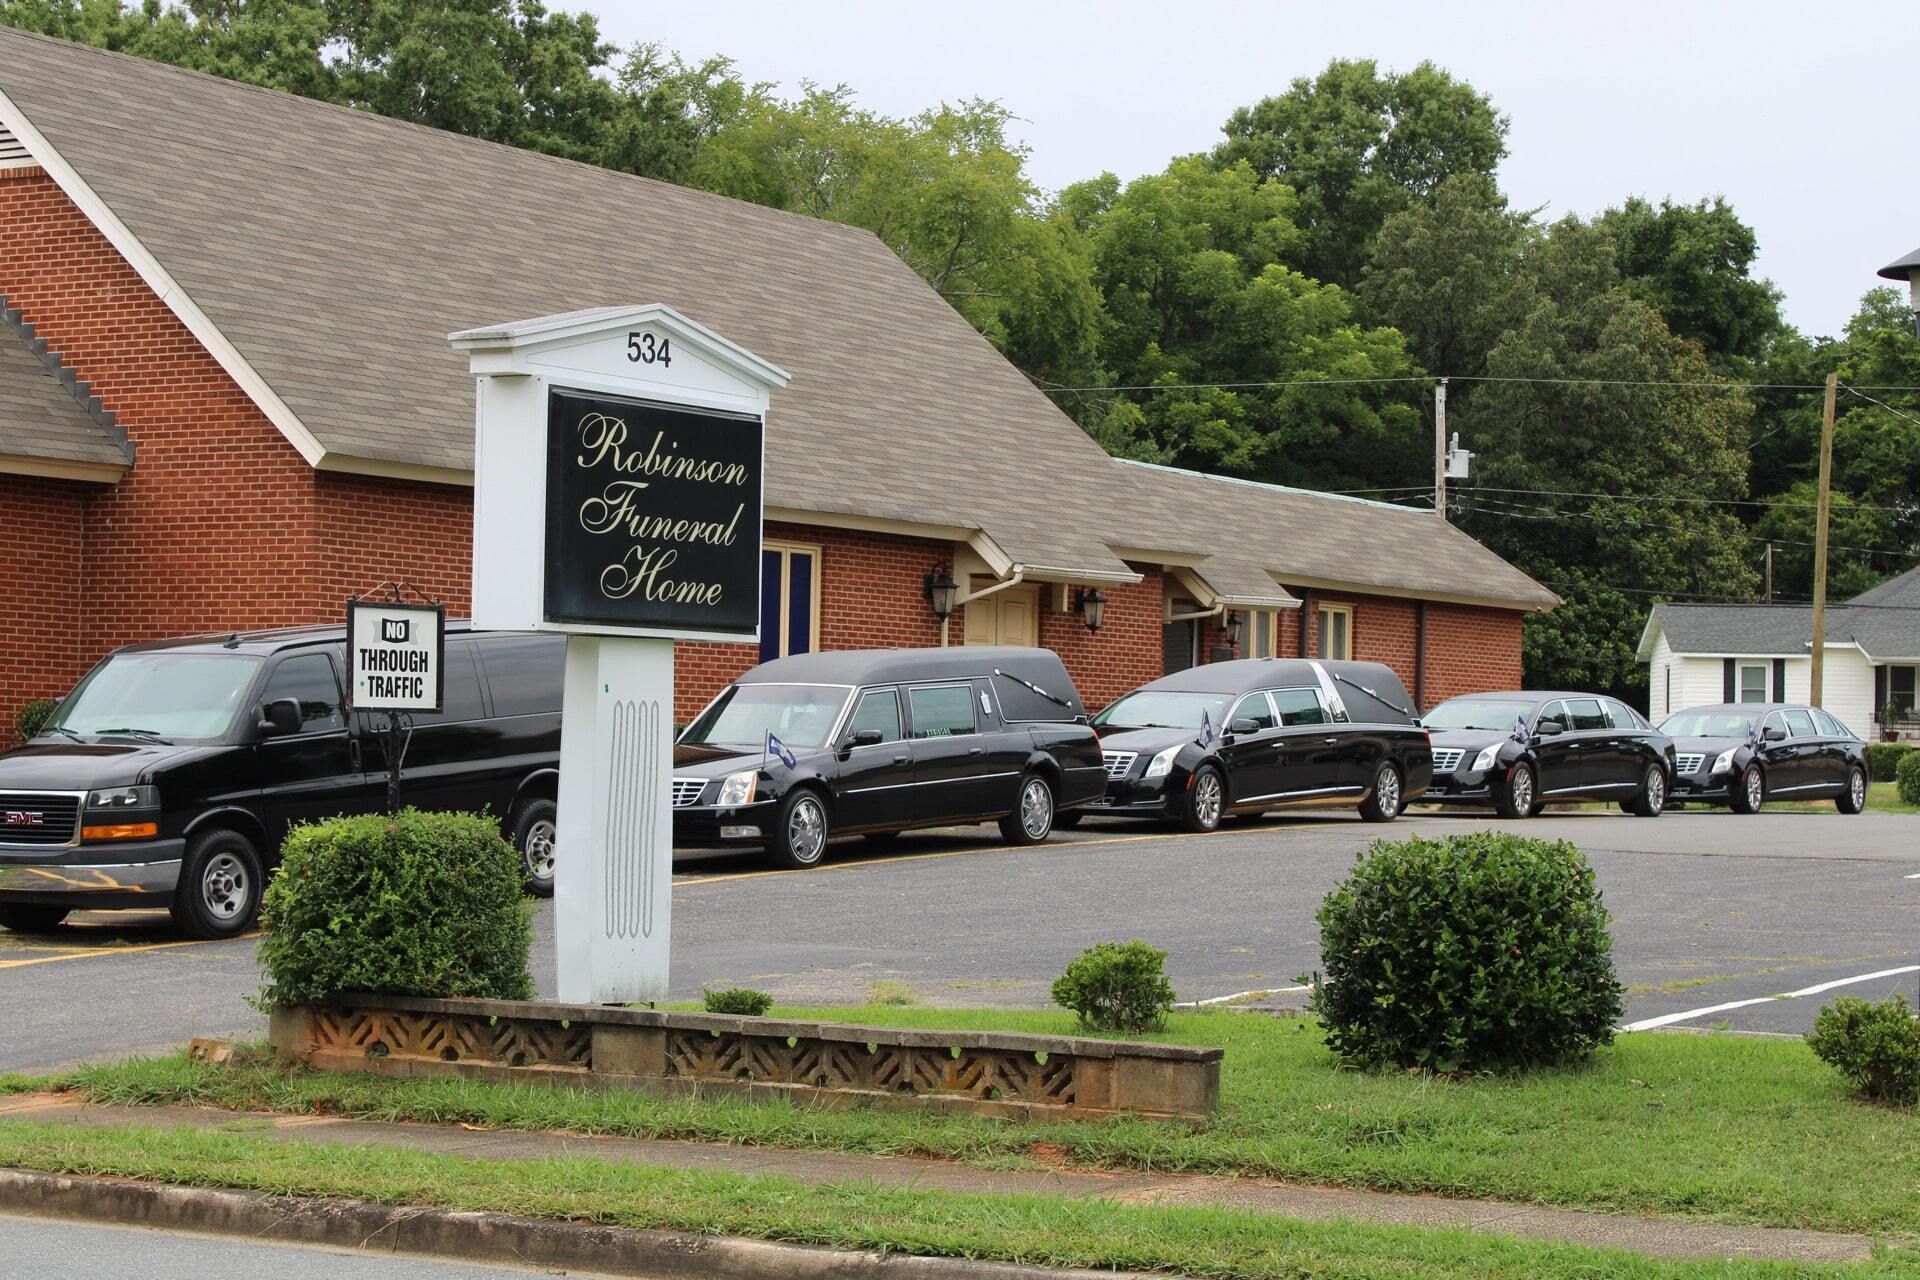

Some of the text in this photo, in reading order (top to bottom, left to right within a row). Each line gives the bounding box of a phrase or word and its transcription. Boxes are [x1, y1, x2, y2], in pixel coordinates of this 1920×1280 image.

[627, 332, 672, 368] 534
[577, 412, 748, 486] Robinson
[579, 480, 745, 547] Funeral
[600, 545, 723, 606] Home
[385, 621, 406, 640] NO
[359, 648, 429, 673] THROUGH
[367, 675, 424, 699] TRAFFIC
[5, 811, 44, 825] GMC
